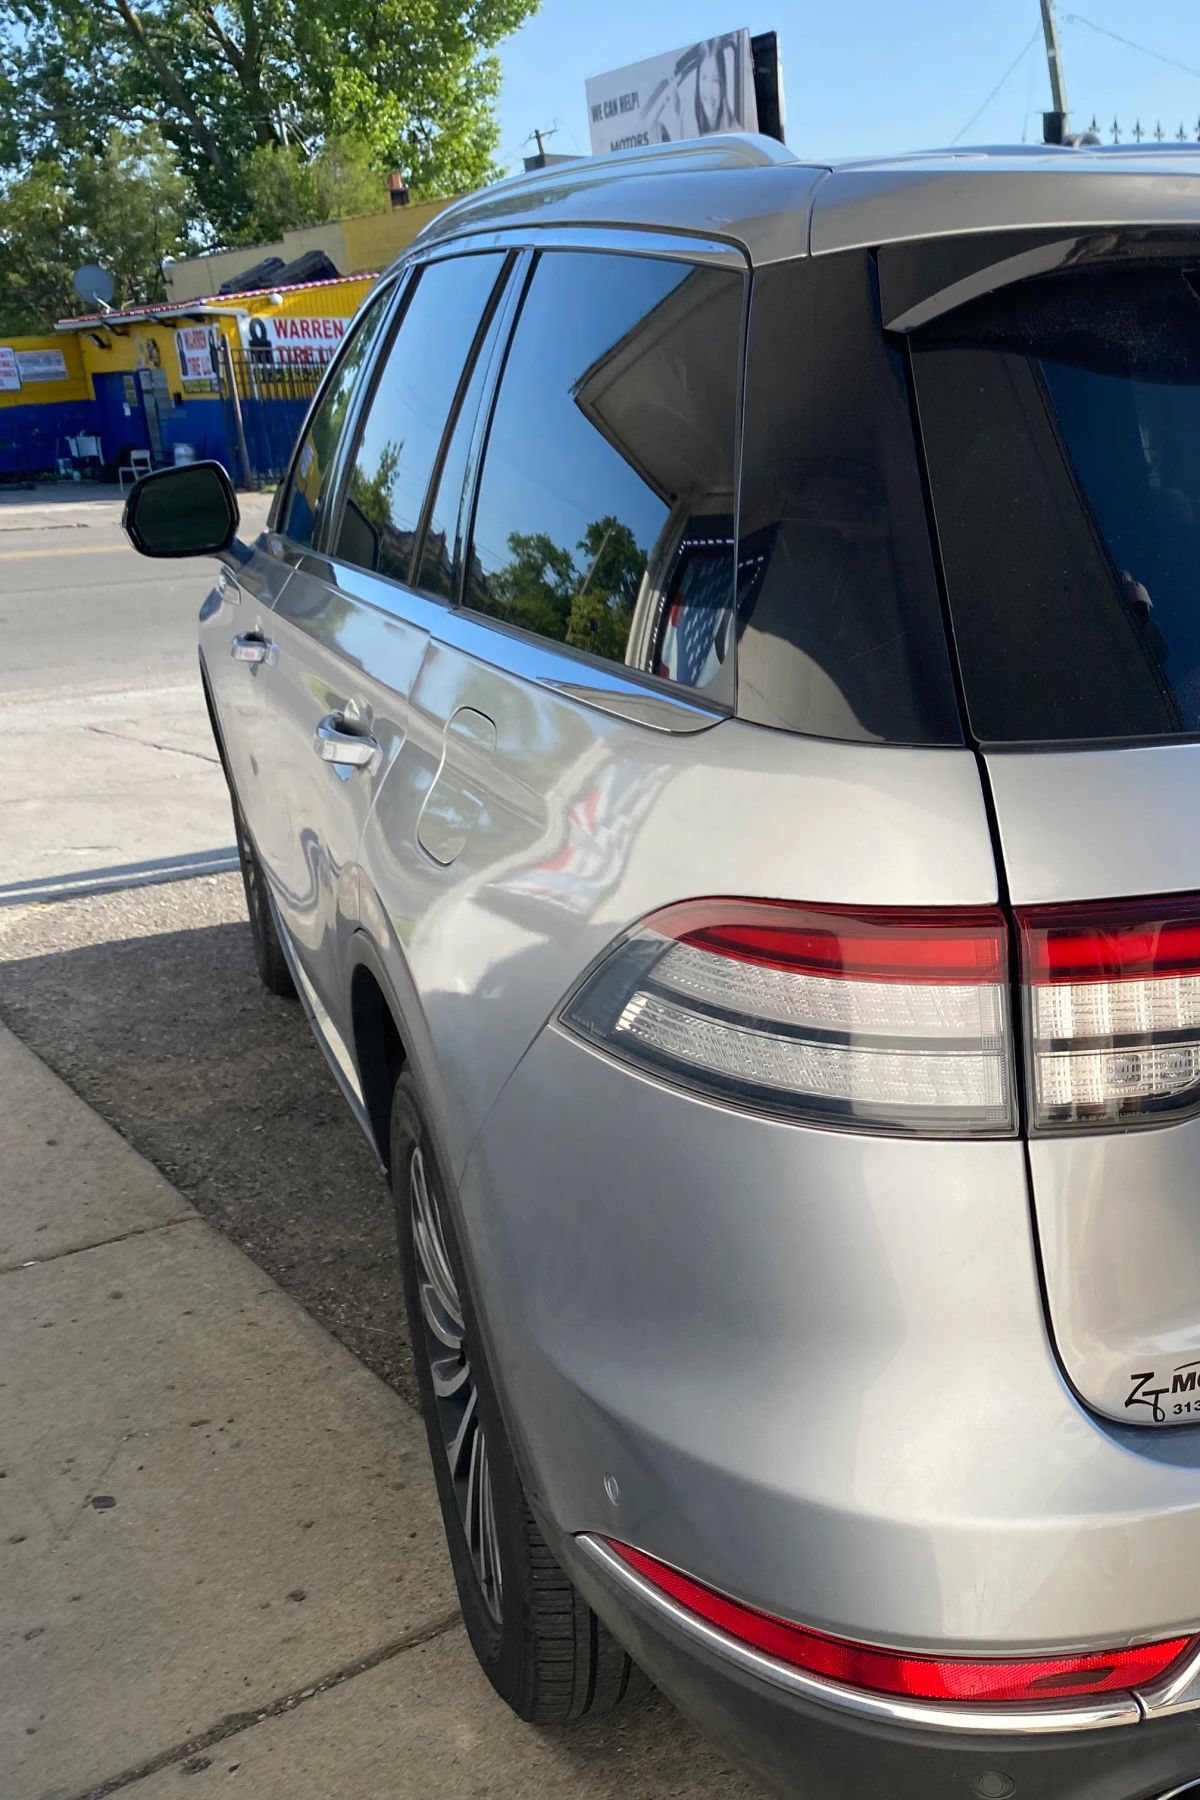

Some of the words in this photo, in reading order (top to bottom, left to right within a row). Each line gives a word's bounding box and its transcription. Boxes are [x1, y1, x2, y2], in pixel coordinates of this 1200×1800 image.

[592, 105, 603, 122] WE
[604, 99, 618, 118] CAN
[611, 132, 648, 151] MOTORS
[273, 318, 344, 339] WARREN
[276, 345, 313, 364] TIRE
